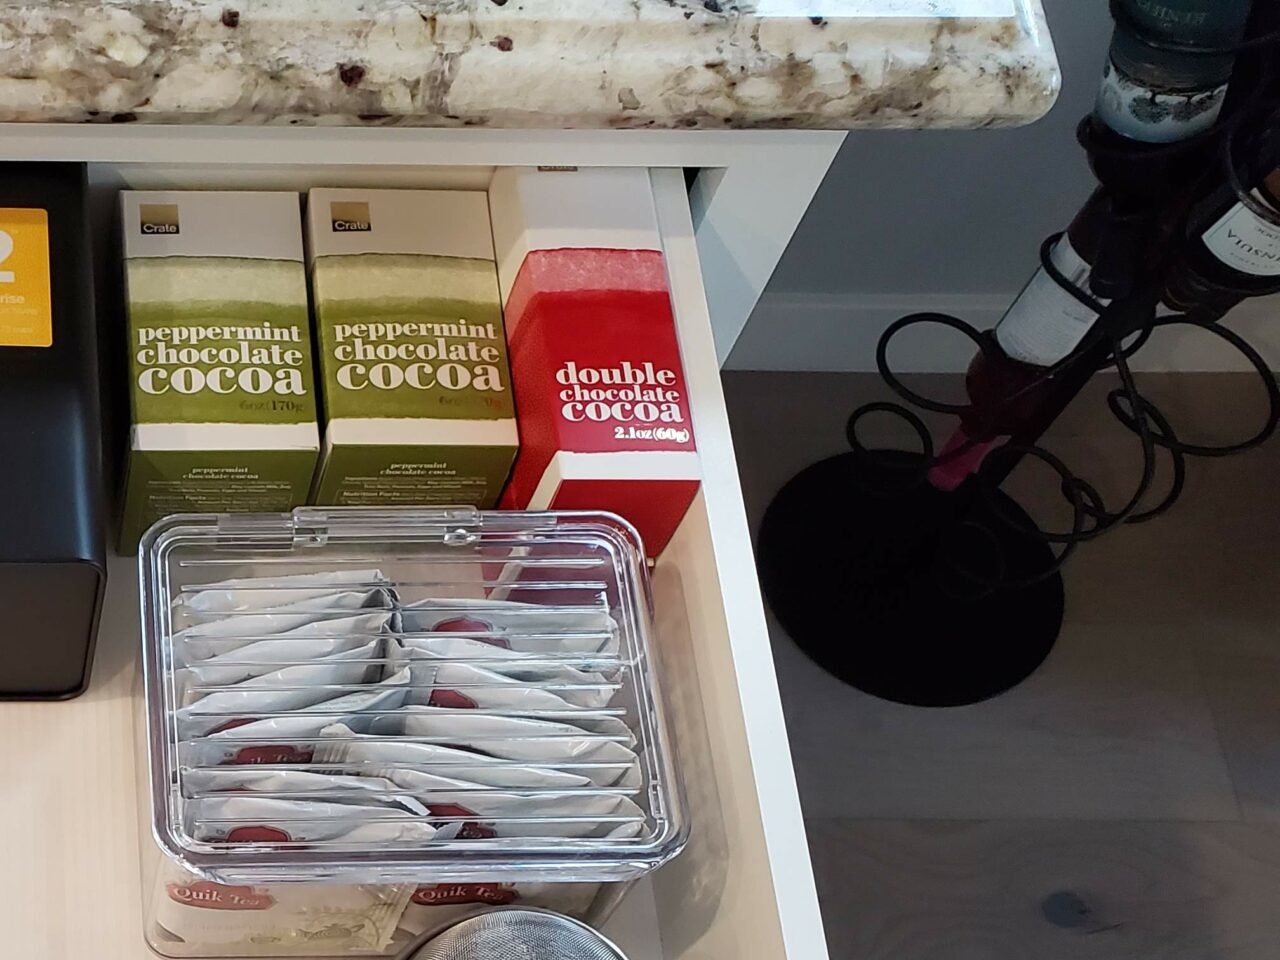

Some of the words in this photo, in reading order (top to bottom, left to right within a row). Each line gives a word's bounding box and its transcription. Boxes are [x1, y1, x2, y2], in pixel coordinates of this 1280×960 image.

[143, 223, 177, 233] Crate
[335, 220, 369, 231] Crate
[138, 321, 302, 346] peppermint
[333, 319, 498, 343] peppermint
[137, 341, 303, 366] chocolate
[334, 338, 500, 363] chocolate
[138, 367, 307, 395] cocoa
[336, 363, 505, 392] cocoa
[556, 361, 676, 386] double
[559, 385, 680, 402] chocolate
[562, 401, 684, 422] cocoa
[174, 886, 222, 901] Quik
[419, 886, 466, 902] Quik
